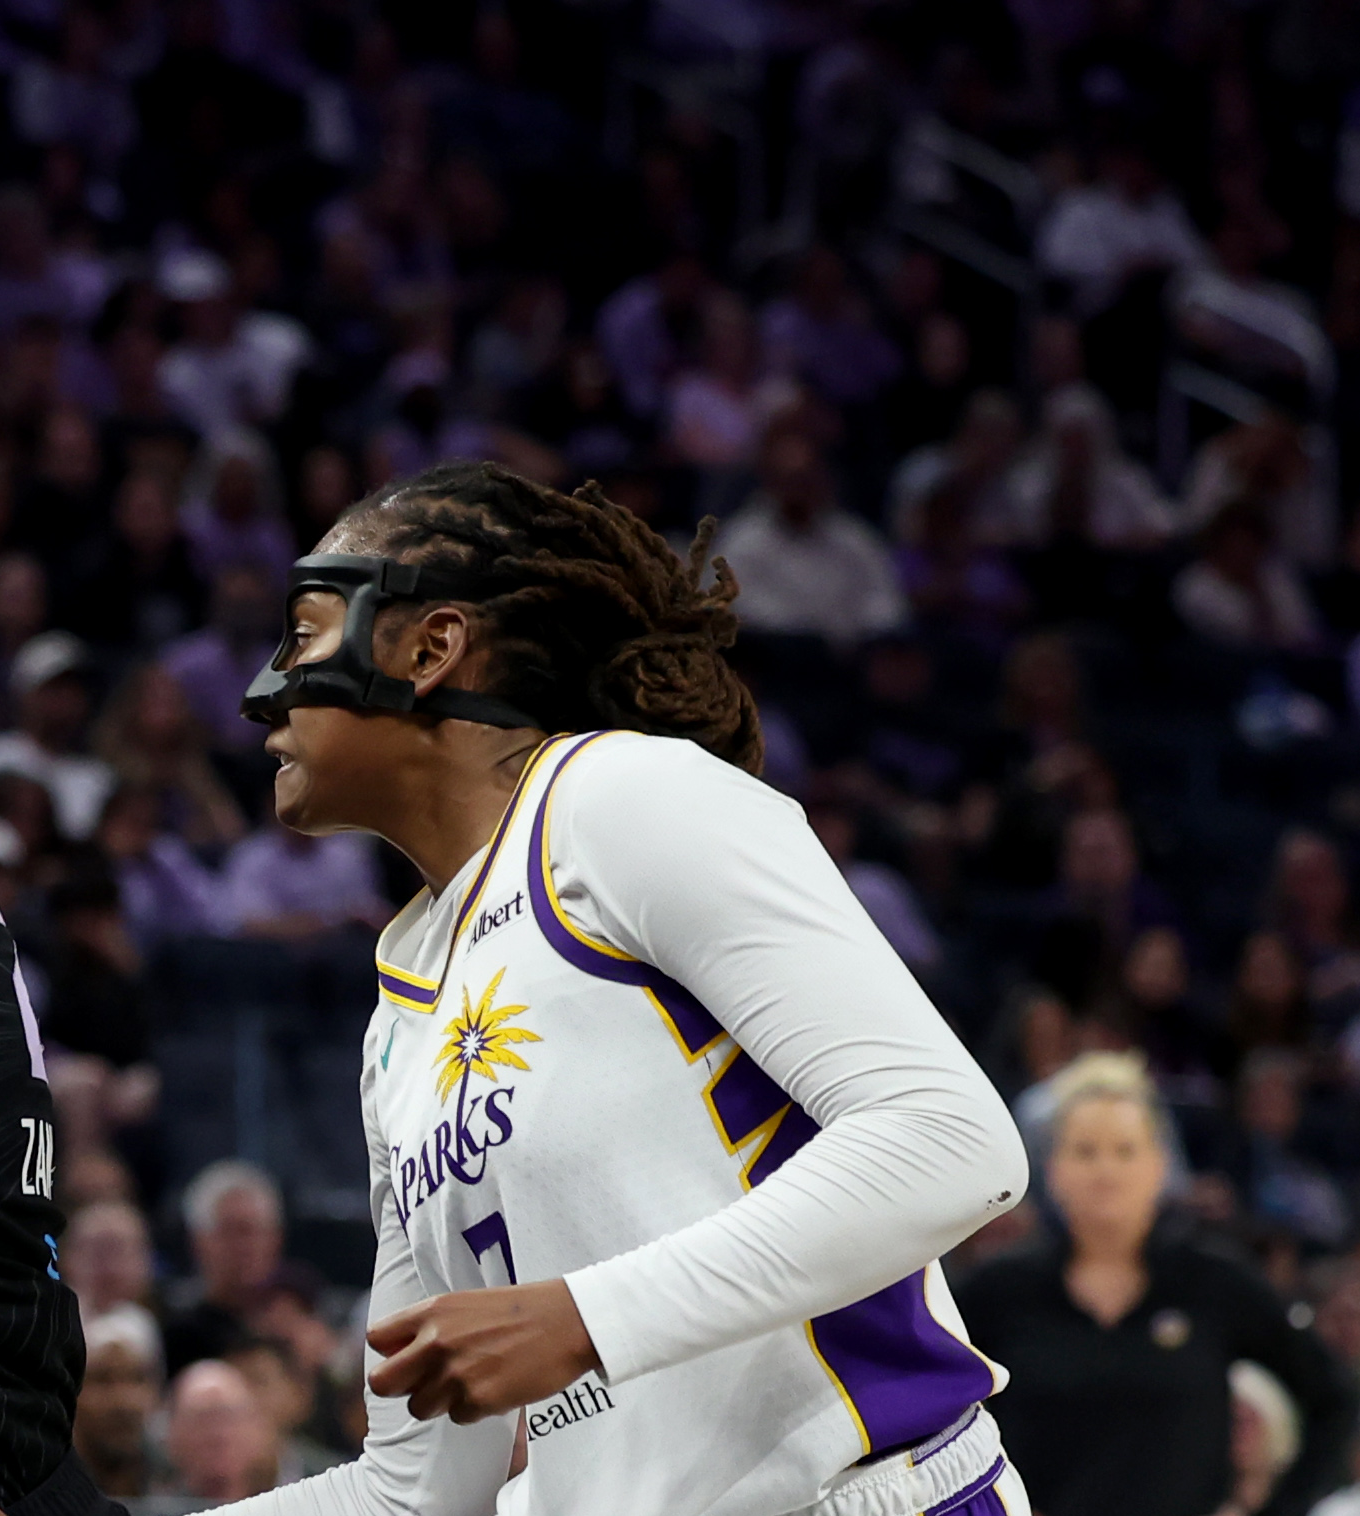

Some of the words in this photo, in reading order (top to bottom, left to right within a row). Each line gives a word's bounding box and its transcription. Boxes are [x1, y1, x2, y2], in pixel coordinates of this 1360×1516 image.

[466, 890, 526, 954] Albert
[389, 1085, 516, 1239] SPARKS
[527, 1381, 616, 1442] ealth
